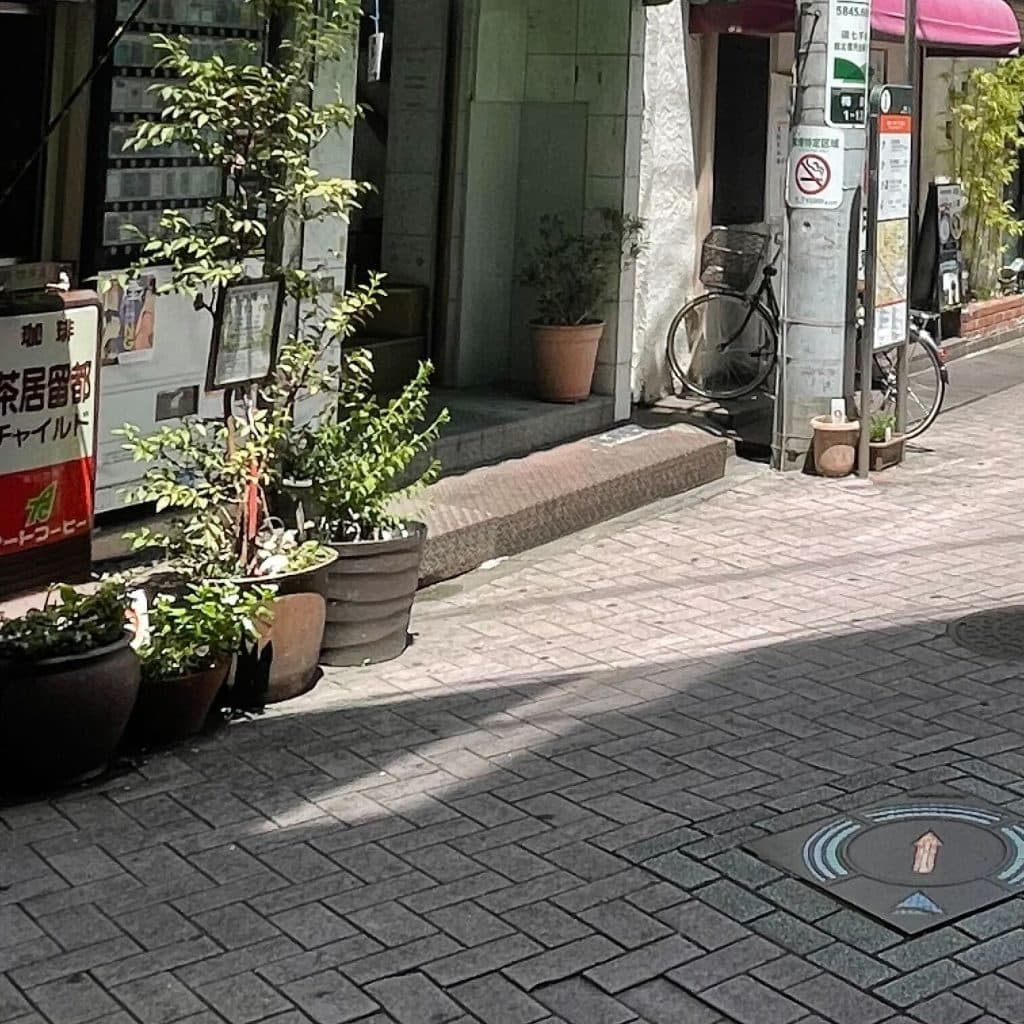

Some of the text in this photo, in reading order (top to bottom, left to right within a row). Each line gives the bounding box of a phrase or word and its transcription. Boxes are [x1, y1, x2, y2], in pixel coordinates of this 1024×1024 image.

[0, 519, 87, 546] ートコーヒー
